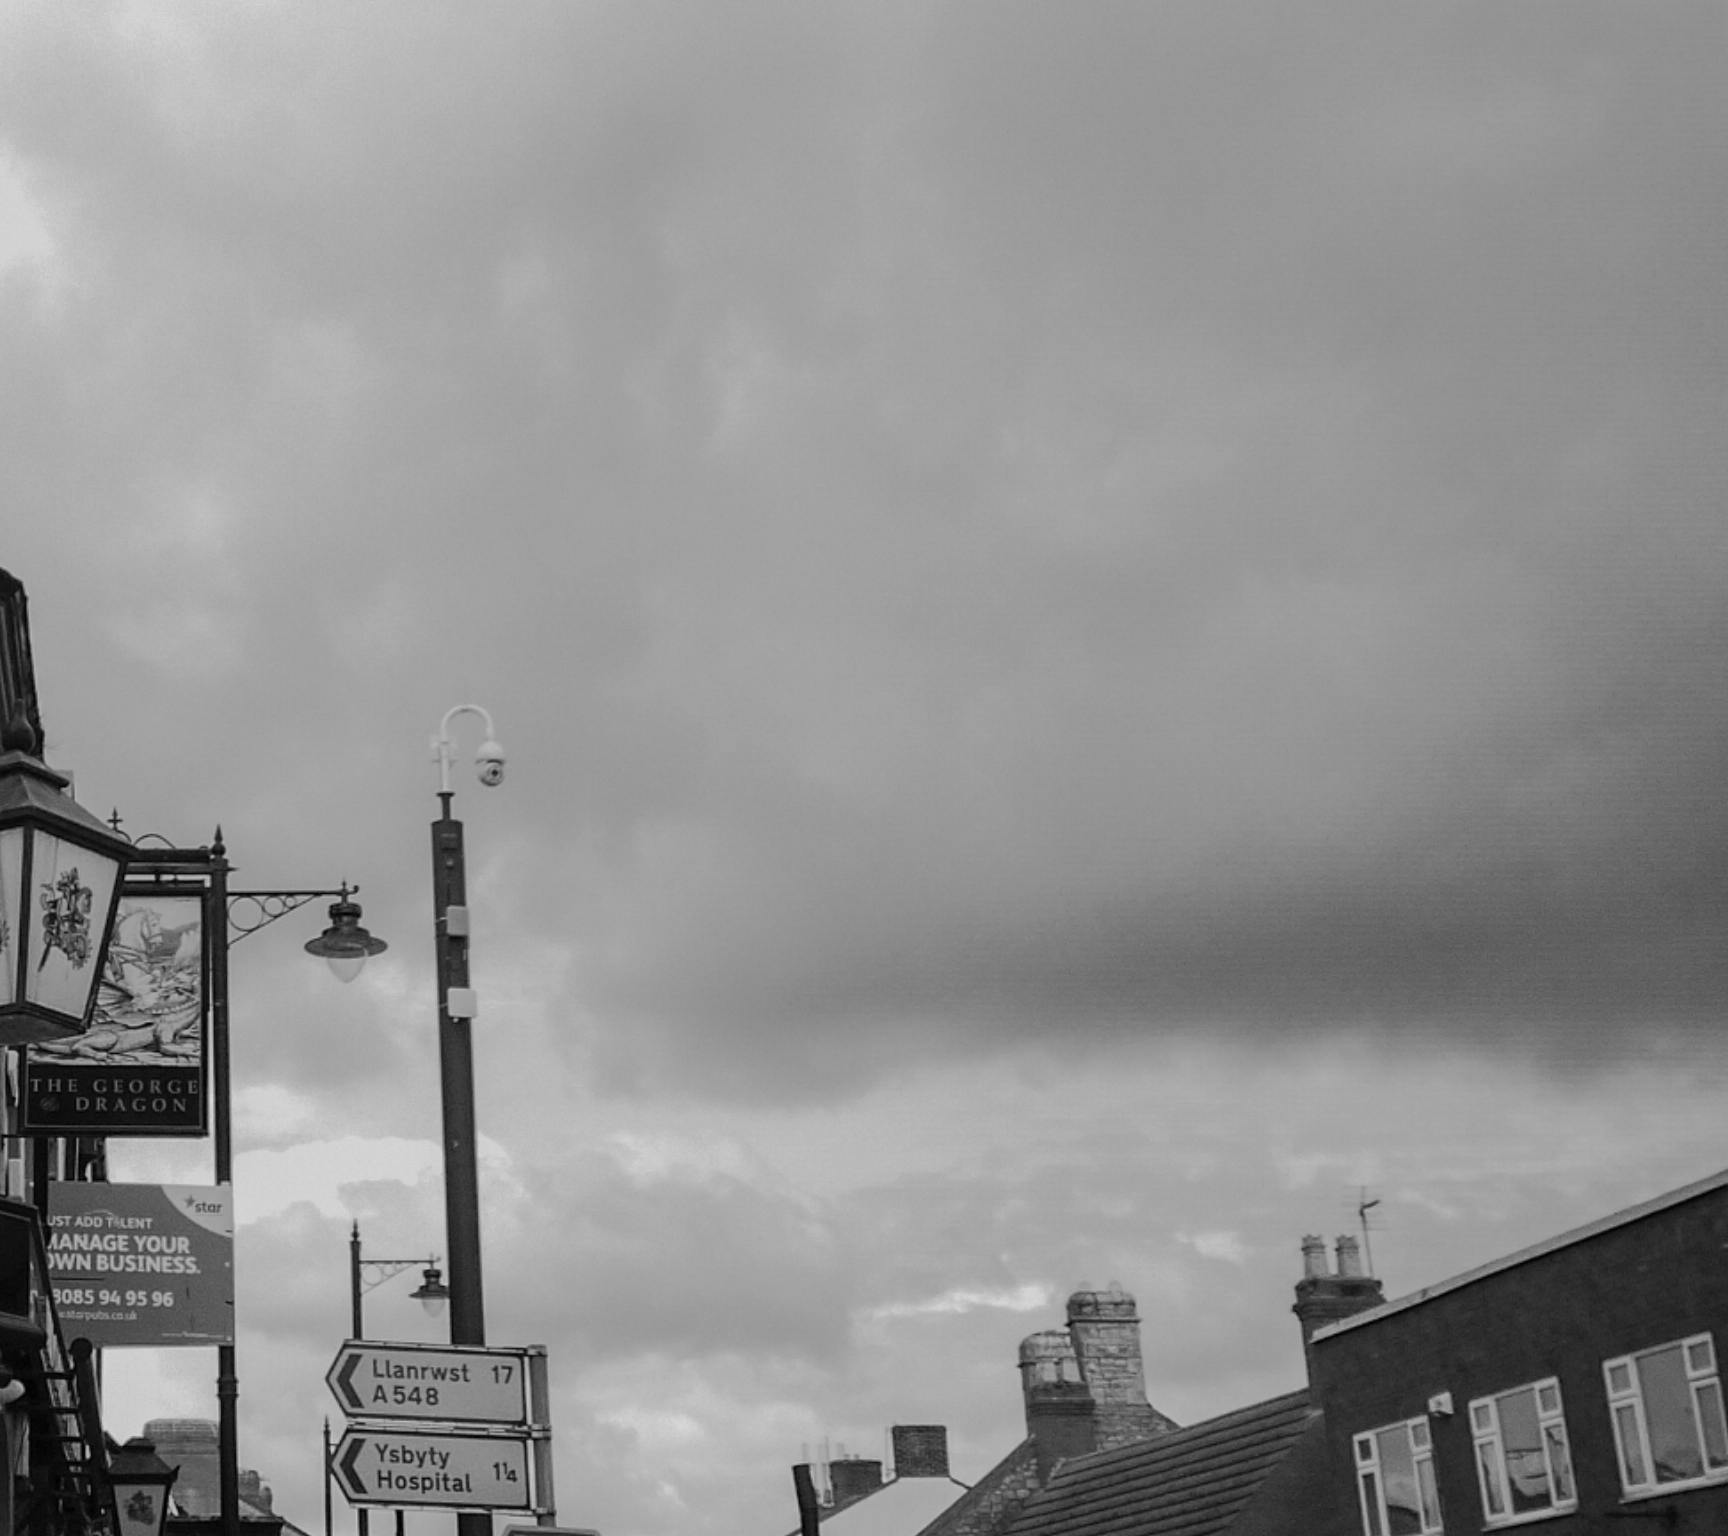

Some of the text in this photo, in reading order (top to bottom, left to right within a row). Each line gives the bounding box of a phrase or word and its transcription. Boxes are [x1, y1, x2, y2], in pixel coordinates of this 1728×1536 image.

[30, 1078, 198, 1095] THE GEORGE
[75, 1096, 187, 1112] DRAGON
[194, 1202, 223, 1213] star
[47, 1215, 72, 1227] UST
[74, 1216, 103, 1228] ADD
[133, 1235, 190, 1254] YOUR
[96, 1253, 202, 1275] BUSINESS.
[98, 1289, 122, 1306] 94
[125, 1290, 148, 1307] 95
[151, 1291, 175, 1308] 96
[373, 1358, 513, 1384] Llanrwst 17
[375, 1443, 450, 1469] Ysbyty
[377, 1470, 472, 1494] Hospital
